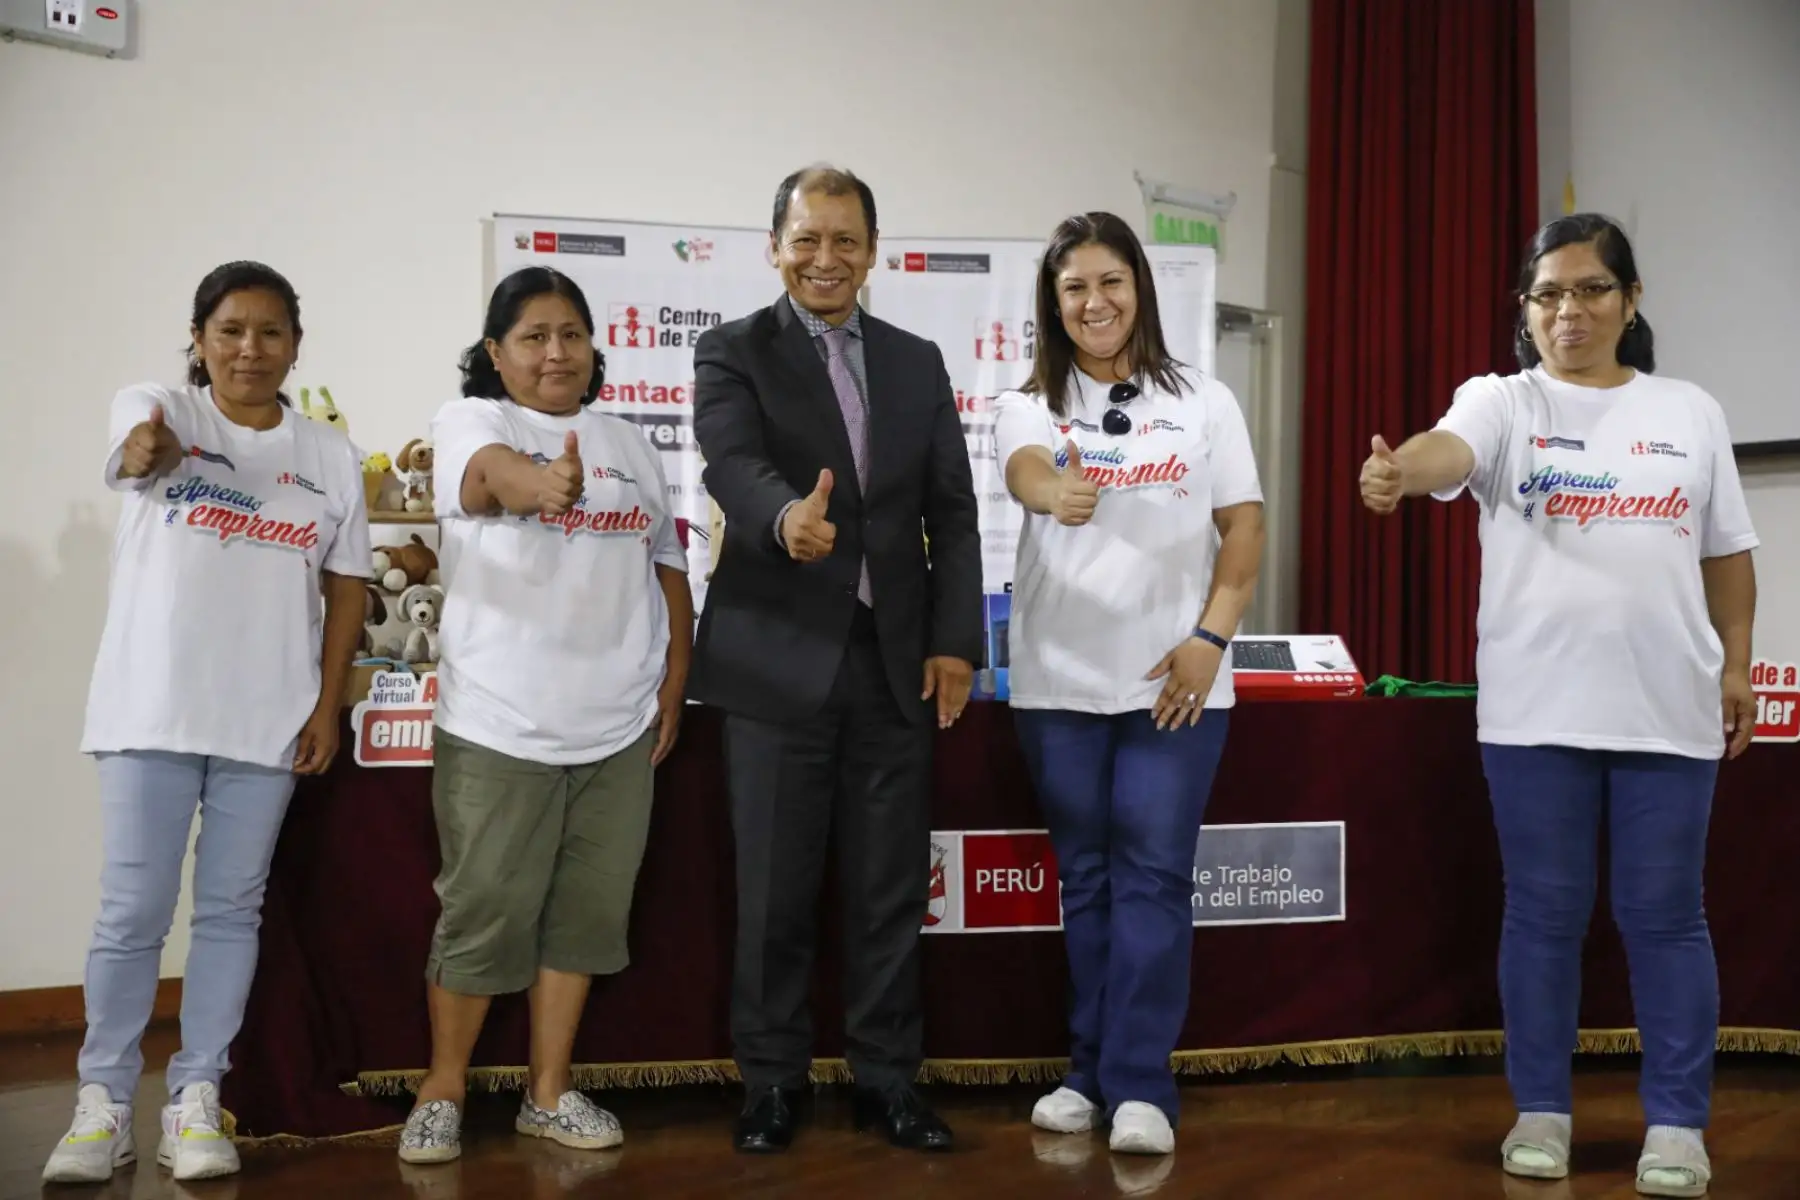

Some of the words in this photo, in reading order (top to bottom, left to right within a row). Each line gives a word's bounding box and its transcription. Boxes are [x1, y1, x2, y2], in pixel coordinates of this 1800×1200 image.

[659, 306, 722, 327] Centro
[659, 328, 683, 348] de
[1081, 454, 1189, 488] mprendo
[1519, 465, 1621, 495] Aprendo
[165, 476, 264, 512] Aprendo
[1545, 487, 1689, 527] emprendo
[187, 504, 319, 549] emprendo
[376, 674, 412, 689] Curso
[1751, 661, 1778, 686] de
[372, 688, 416, 704] virtual
[975, 861, 1045, 894] PERÚ
[1217, 864, 1292, 887] Trabajo
[1210, 886, 1242, 907] del
[1249, 884, 1324, 910] Empleo
